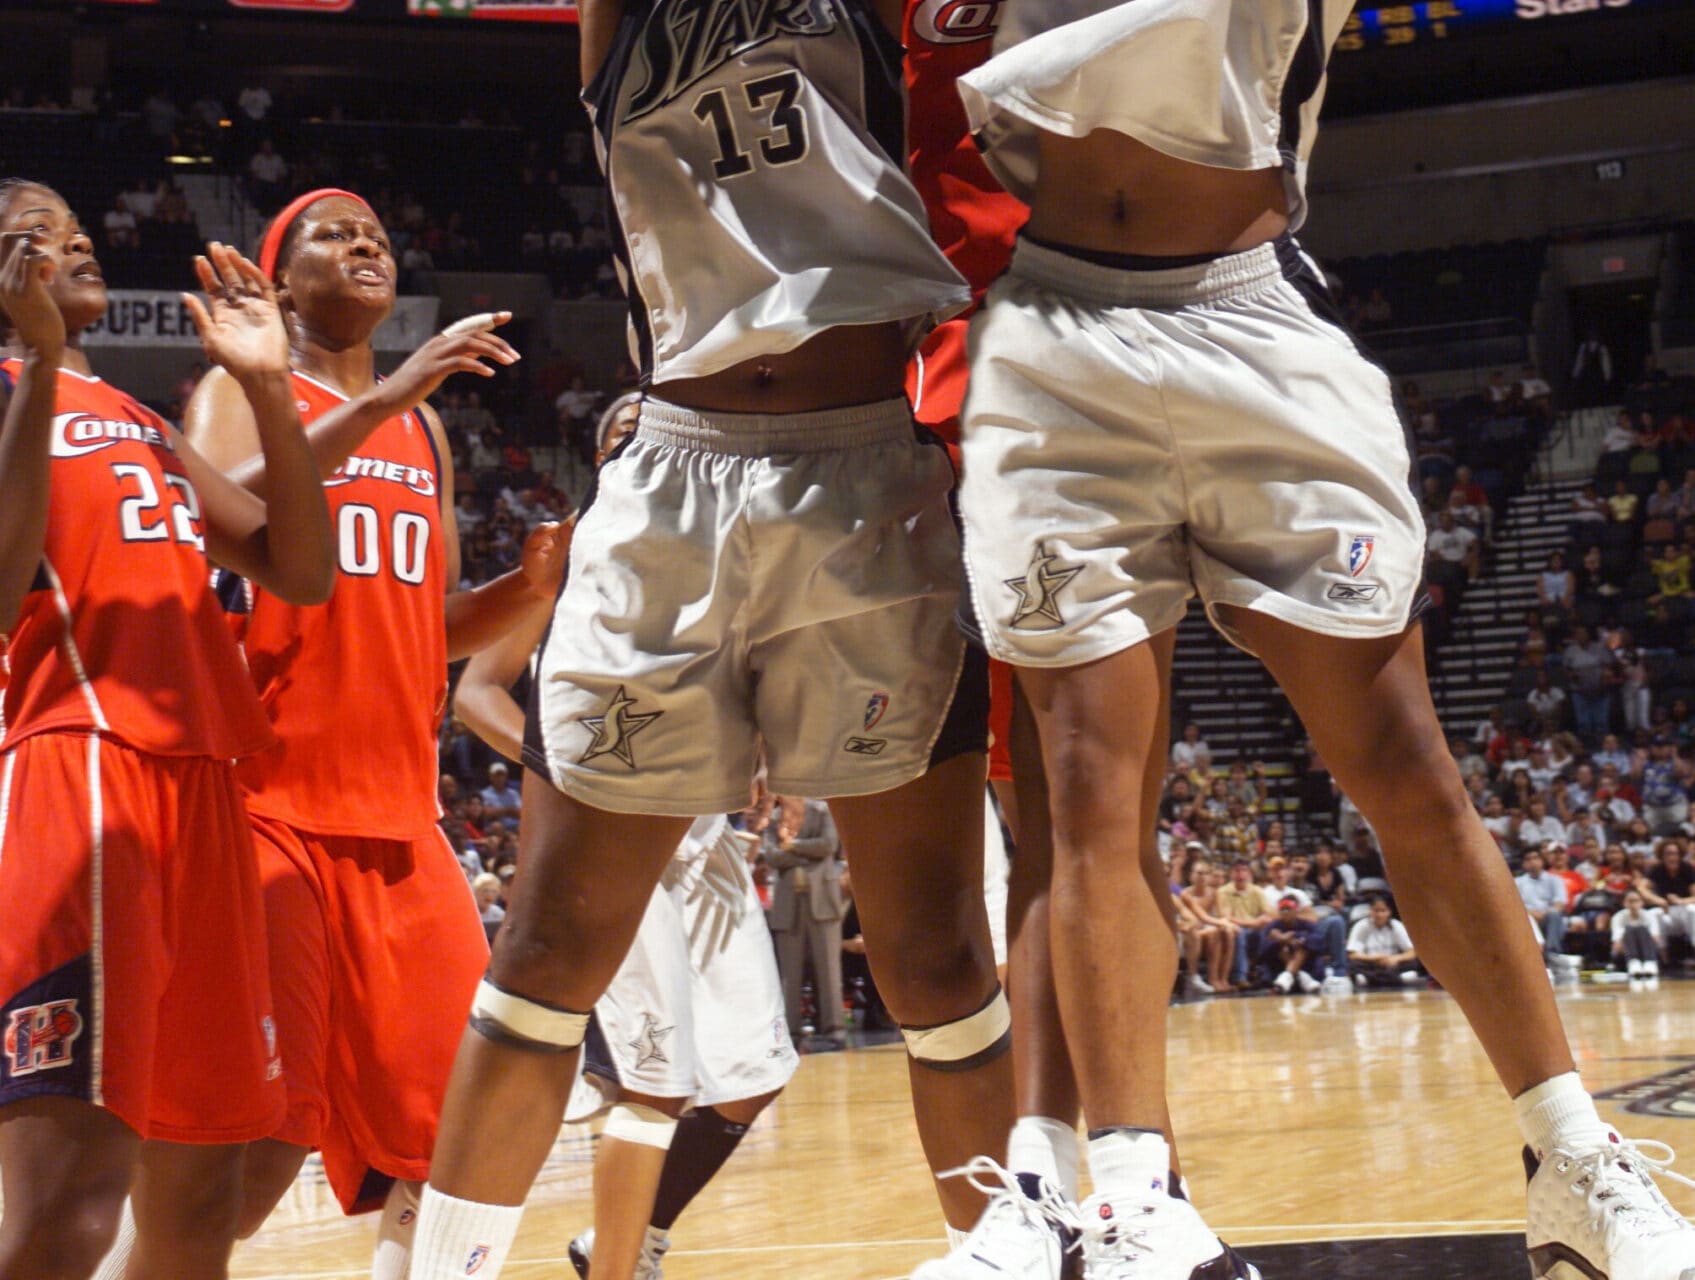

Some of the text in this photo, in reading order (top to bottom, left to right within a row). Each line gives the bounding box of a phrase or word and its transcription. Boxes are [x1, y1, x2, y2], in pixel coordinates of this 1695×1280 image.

[691, 68, 809, 181] 13
[110, 462, 206, 553] 22
[338, 503, 430, 587] 00
